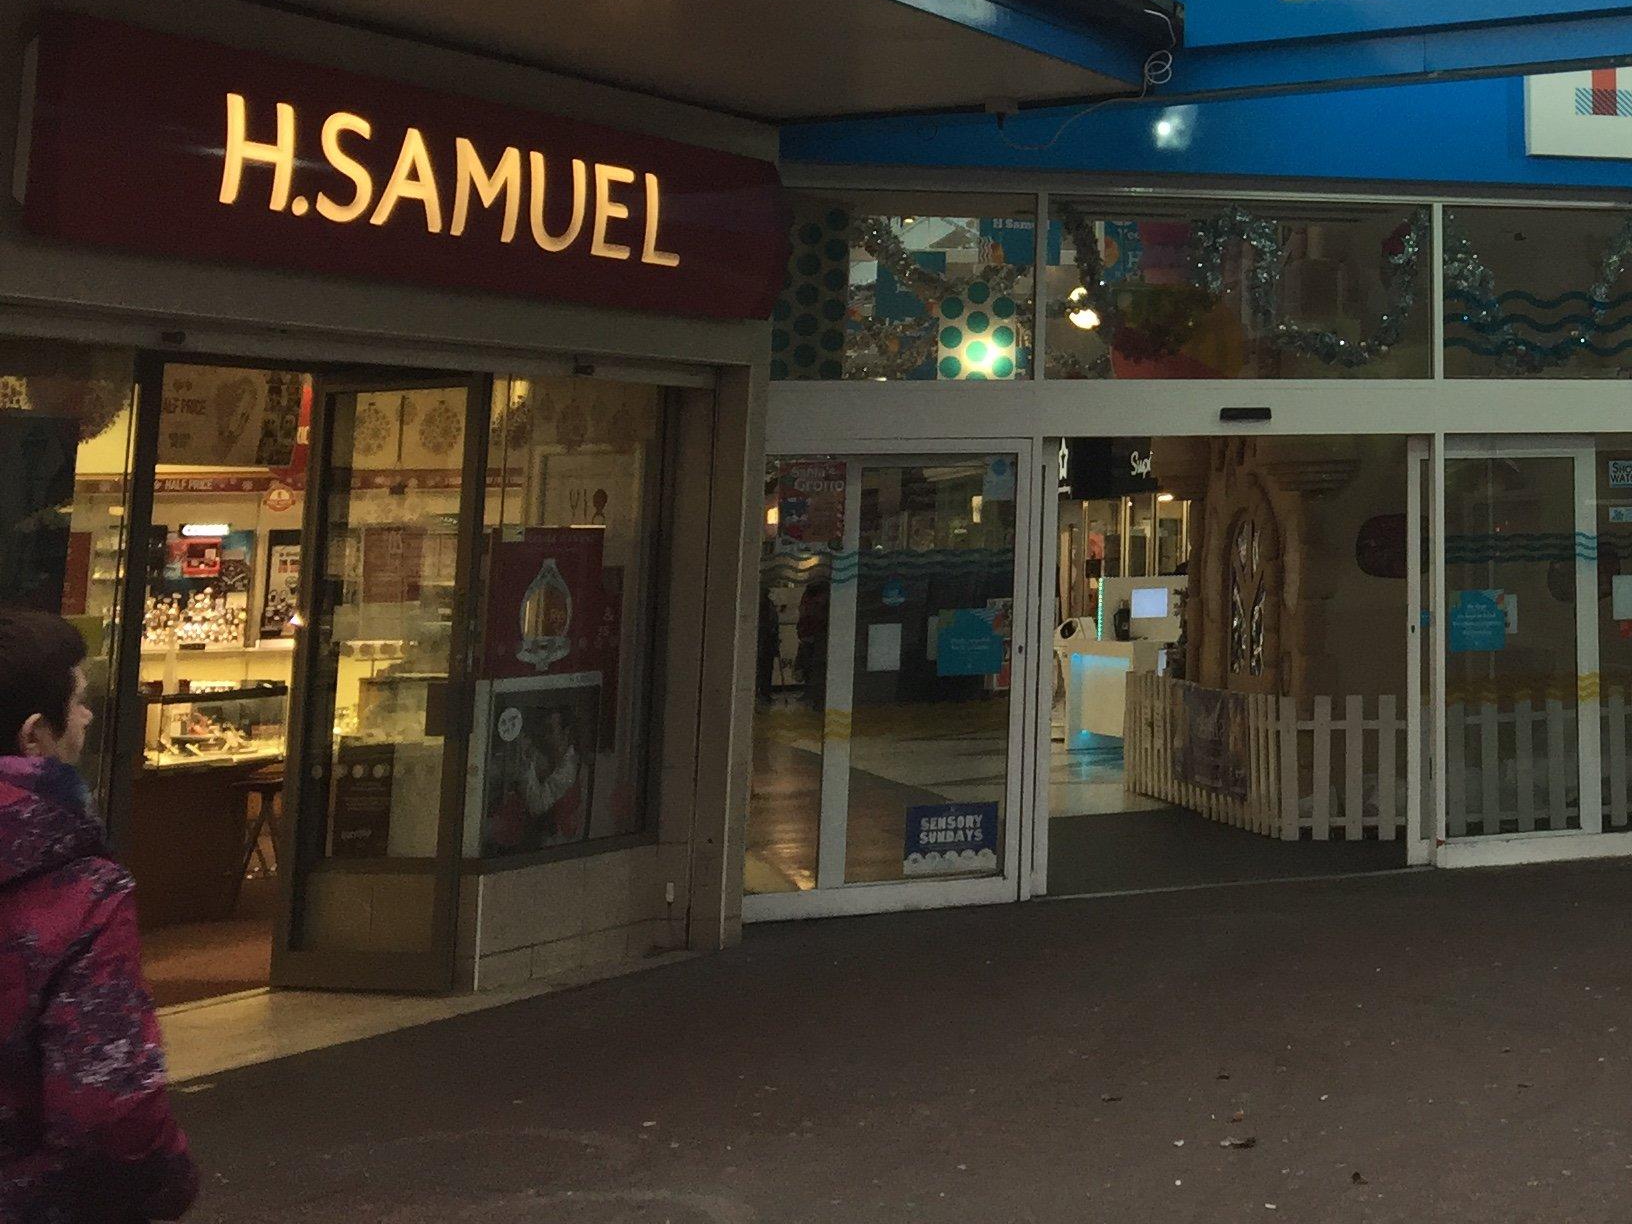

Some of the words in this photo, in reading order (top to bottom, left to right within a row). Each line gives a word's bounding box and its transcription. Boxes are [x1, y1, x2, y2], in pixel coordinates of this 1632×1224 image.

[219, 92, 681, 268] H.SAMUEL
[920, 813, 984, 831] SENSORY
[919, 828, 985, 845] SUNDAYS
